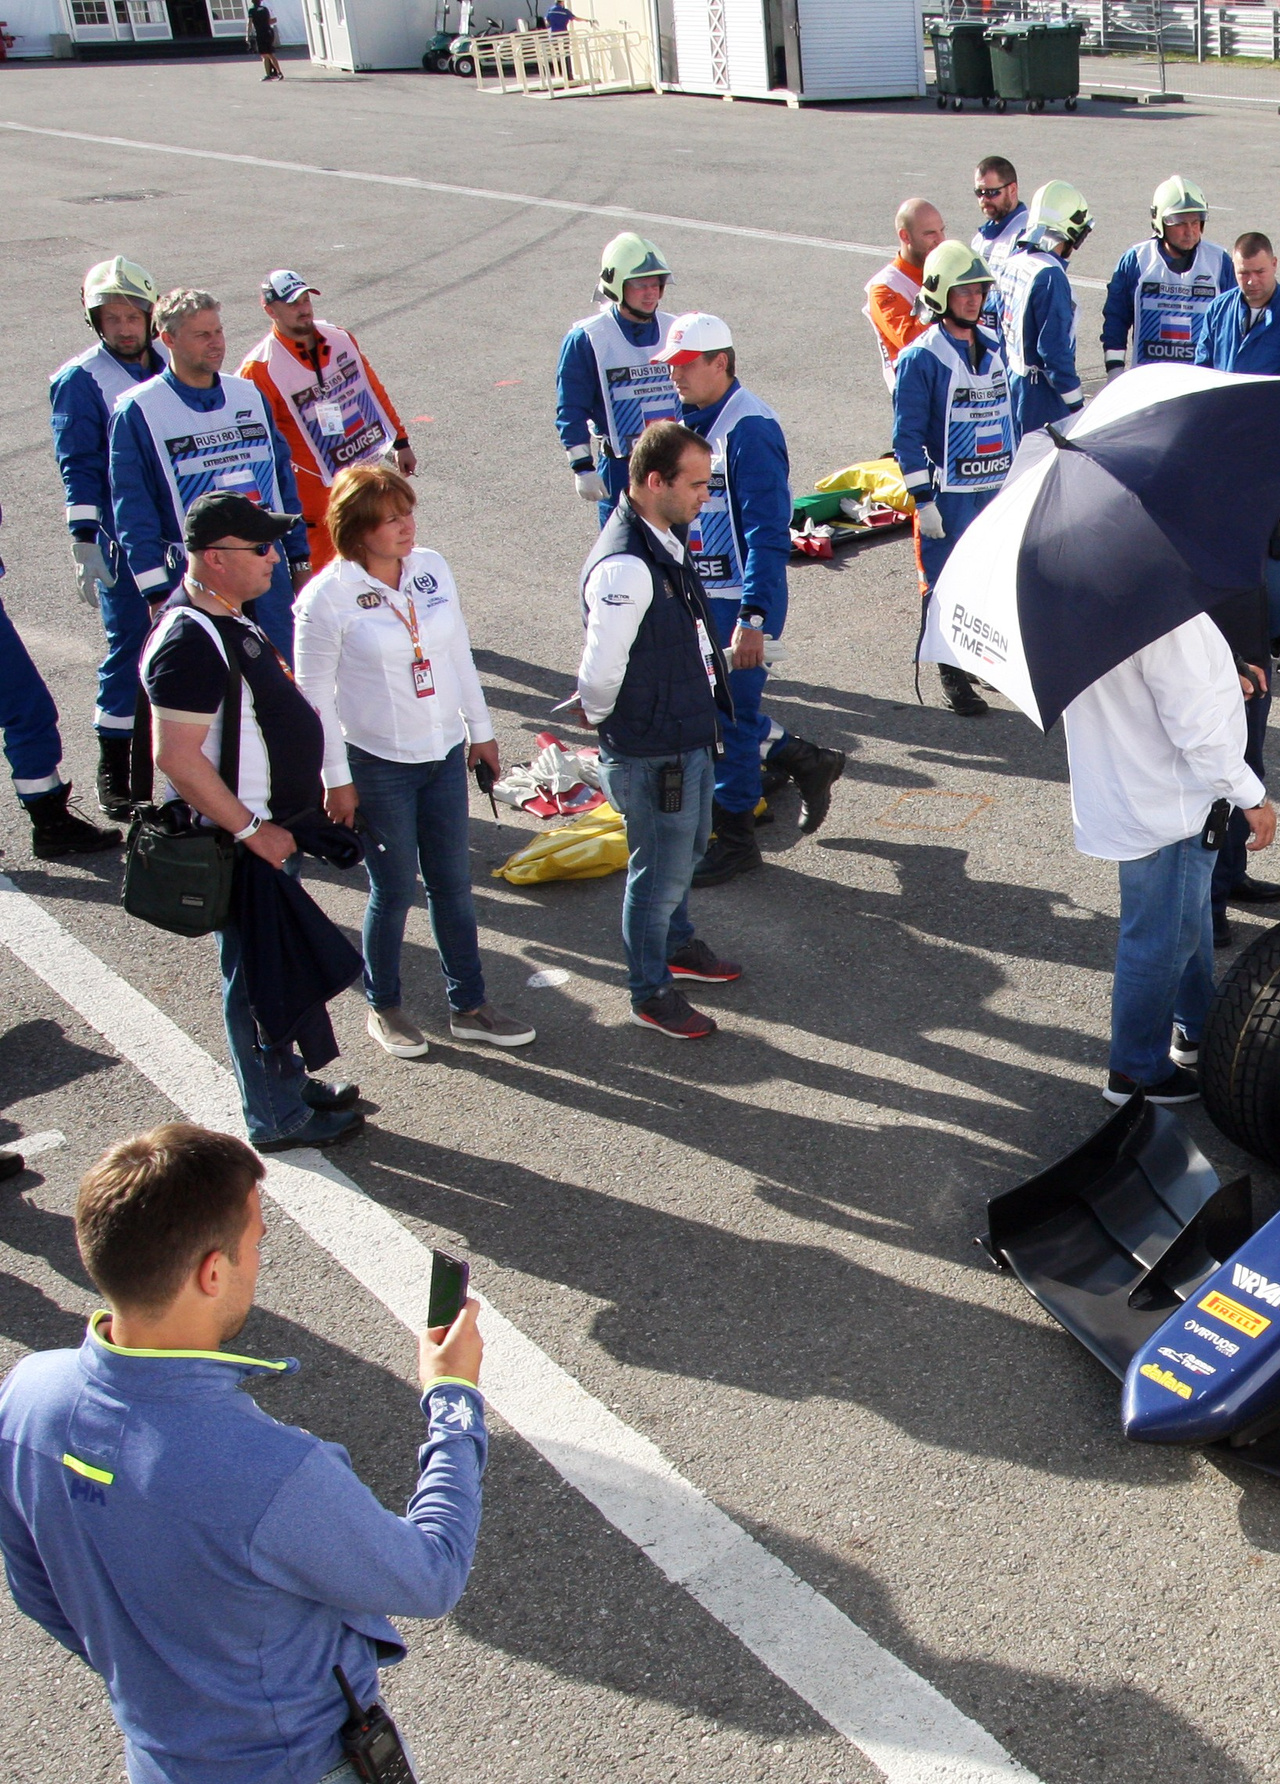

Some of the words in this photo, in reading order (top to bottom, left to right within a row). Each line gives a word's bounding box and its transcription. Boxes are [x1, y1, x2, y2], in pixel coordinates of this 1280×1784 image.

[336, 424, 382, 462] COURSE
[961, 456, 1010, 475] COURSE
[360, 593, 380, 608] FIA
[951, 624, 984, 658] TIME
[1206, 1296, 1262, 1332] PIRELLI
[1192, 1323, 1240, 1355] VIRTUOSI
